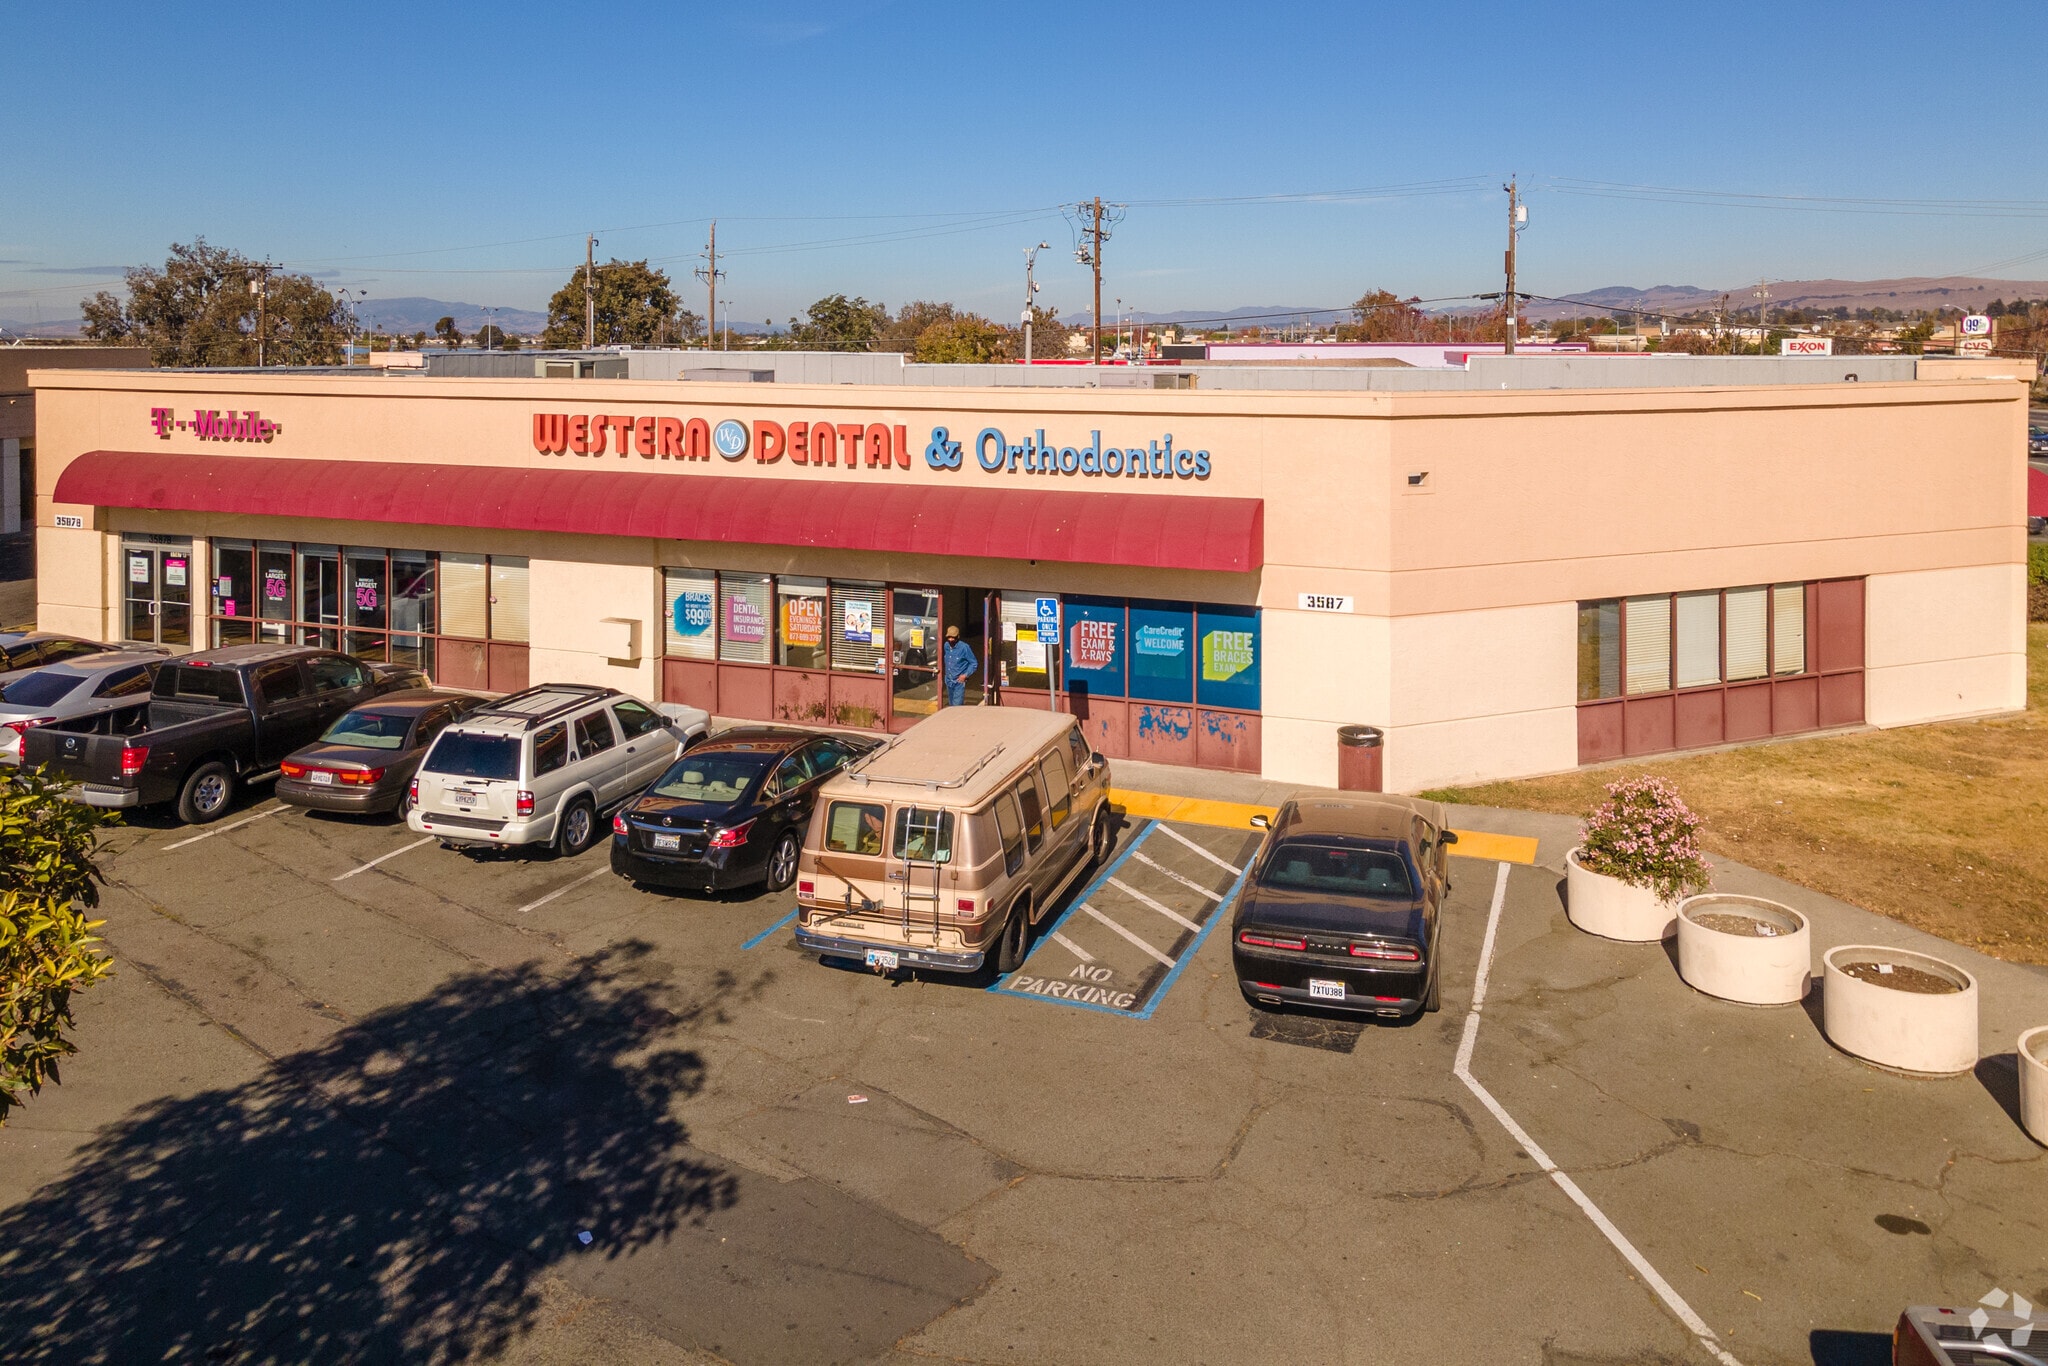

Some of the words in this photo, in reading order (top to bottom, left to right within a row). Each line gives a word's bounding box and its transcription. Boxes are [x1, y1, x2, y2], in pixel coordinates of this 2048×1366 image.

[1789, 342, 1825, 354] EXXON
[1964, 341, 1989, 350] CVS
[533, 413, 711, 460] WESTERN
[753, 419, 912, 470] DENTAL
[925, 426, 963, 469] &
[976, 427, 1212, 478] Orthodontics
[265, 572, 287, 580] LARGEST
[266, 579, 287, 598] 5G
[355, 581, 378, 589] LARGEST
[356, 588, 377, 607] 5G
[685, 592, 712, 603] BRACES
[1307, 595, 1344, 610] 3587
[733, 603, 761, 615] DENTAL
[789, 599, 822, 617] OPEN
[733, 614, 765, 625] INSURANCE
[789, 615, 817, 625] EVENINGS
[1037, 616, 1058, 624] PARKING
[733, 624, 765, 636] WELCOME
[789, 623, 822, 634] SATURDAYS
[1080, 620, 1117, 640] FREE
[1080, 637, 1106, 651] EXAM
[1108, 639, 1116, 652] &
[1143, 637, 1185, 651] WELCOME
[1213, 630, 1254, 652] FREE
[1080, 649, 1113, 662] X-RAYS
[1213, 650, 1254, 665] BRACES
[1213, 662, 1237, 673] EXAM
[1069, 963, 1113, 983] NO
[1008, 975, 1137, 1010] PARKING
[1311, 984, 1343, 997] 7XTU388
